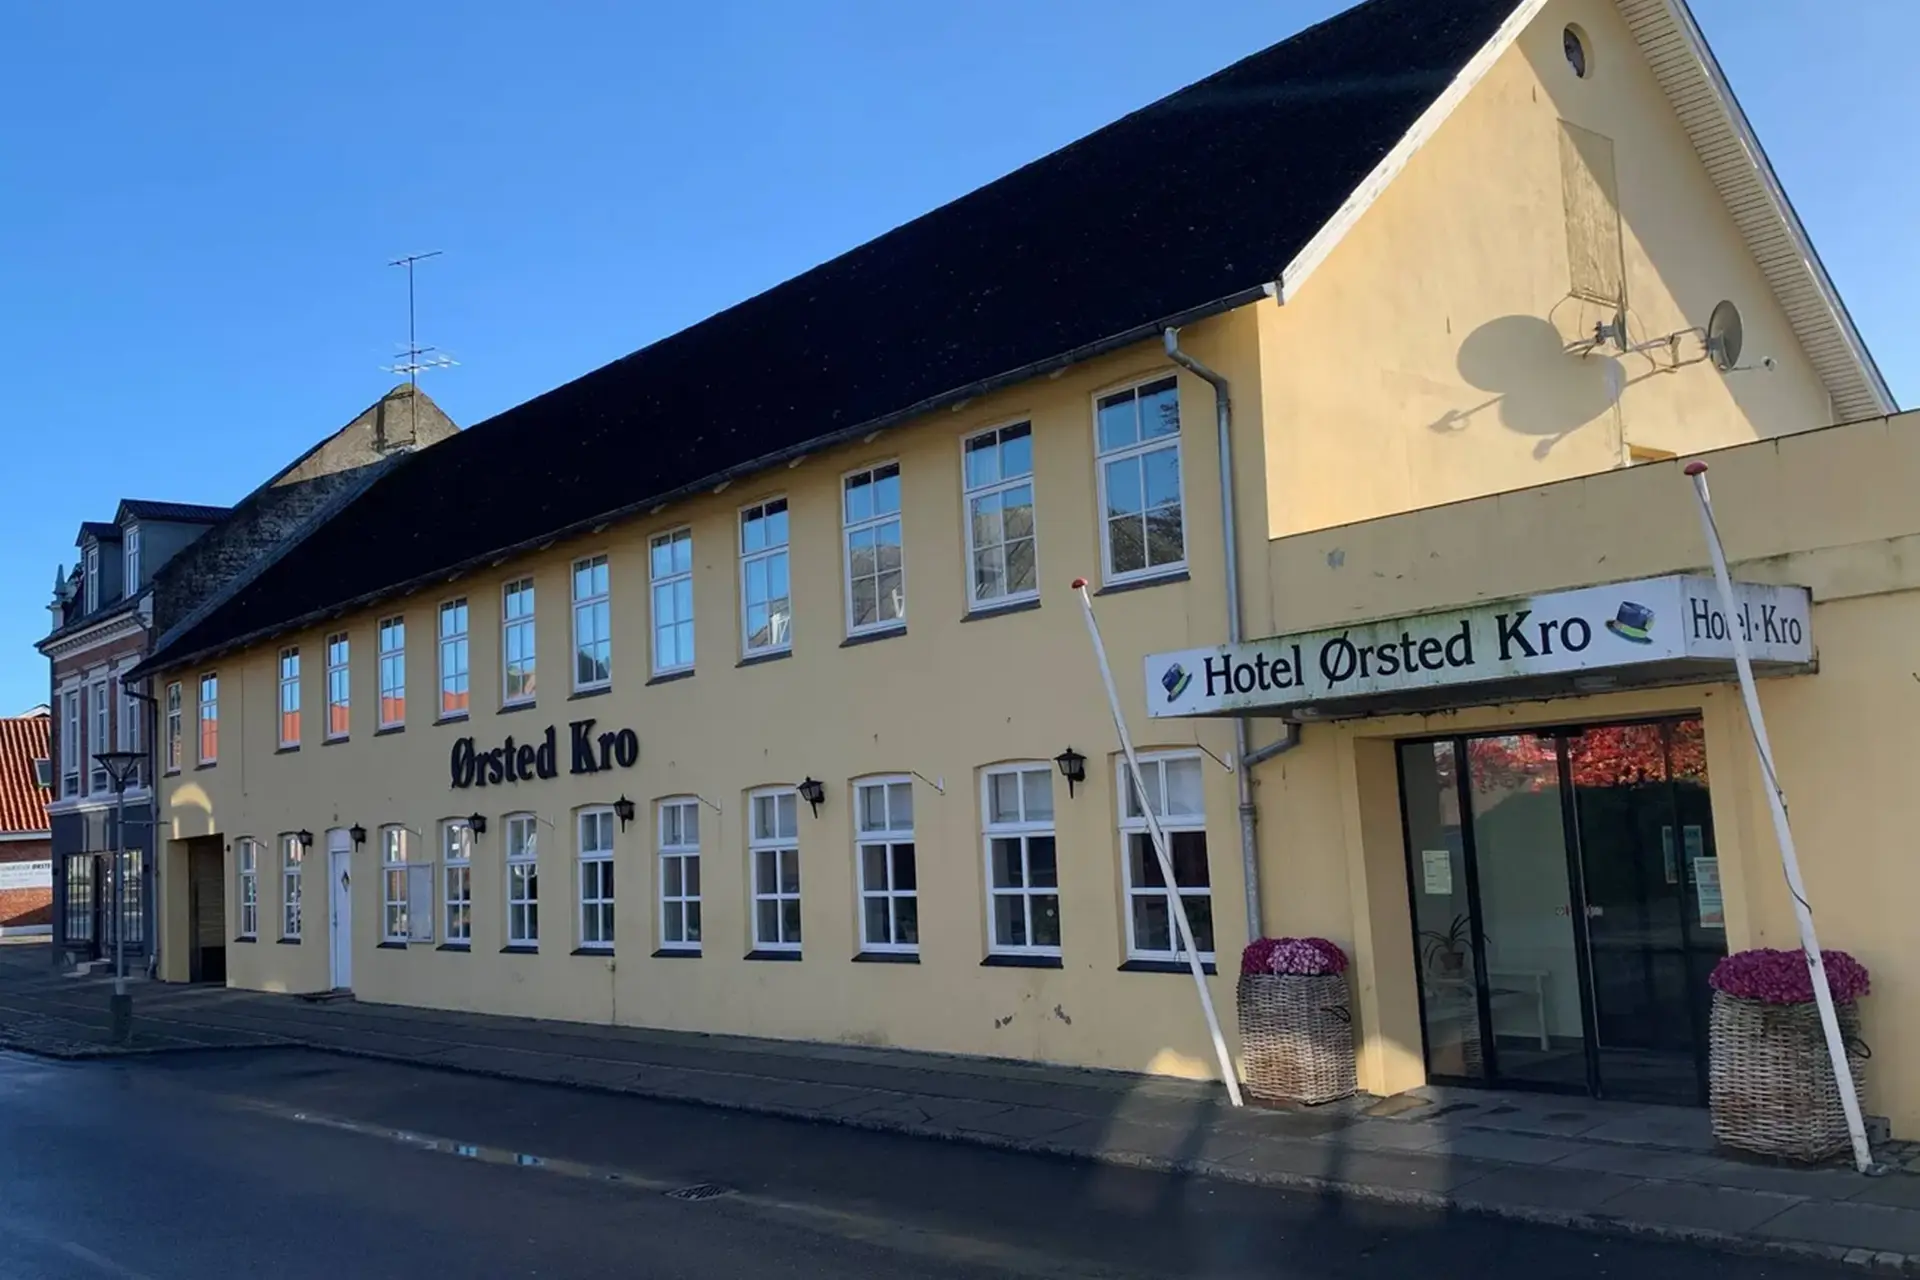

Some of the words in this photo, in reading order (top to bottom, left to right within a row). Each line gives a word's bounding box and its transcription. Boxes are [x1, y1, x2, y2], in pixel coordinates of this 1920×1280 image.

[1203, 644, 1305, 697] Hotel
[1319, 619, 1476, 690] Ørsted
[1494, 609, 1592, 661] Kro
[450, 724, 559, 789] Ørsted
[569, 718, 640, 774] Kro
